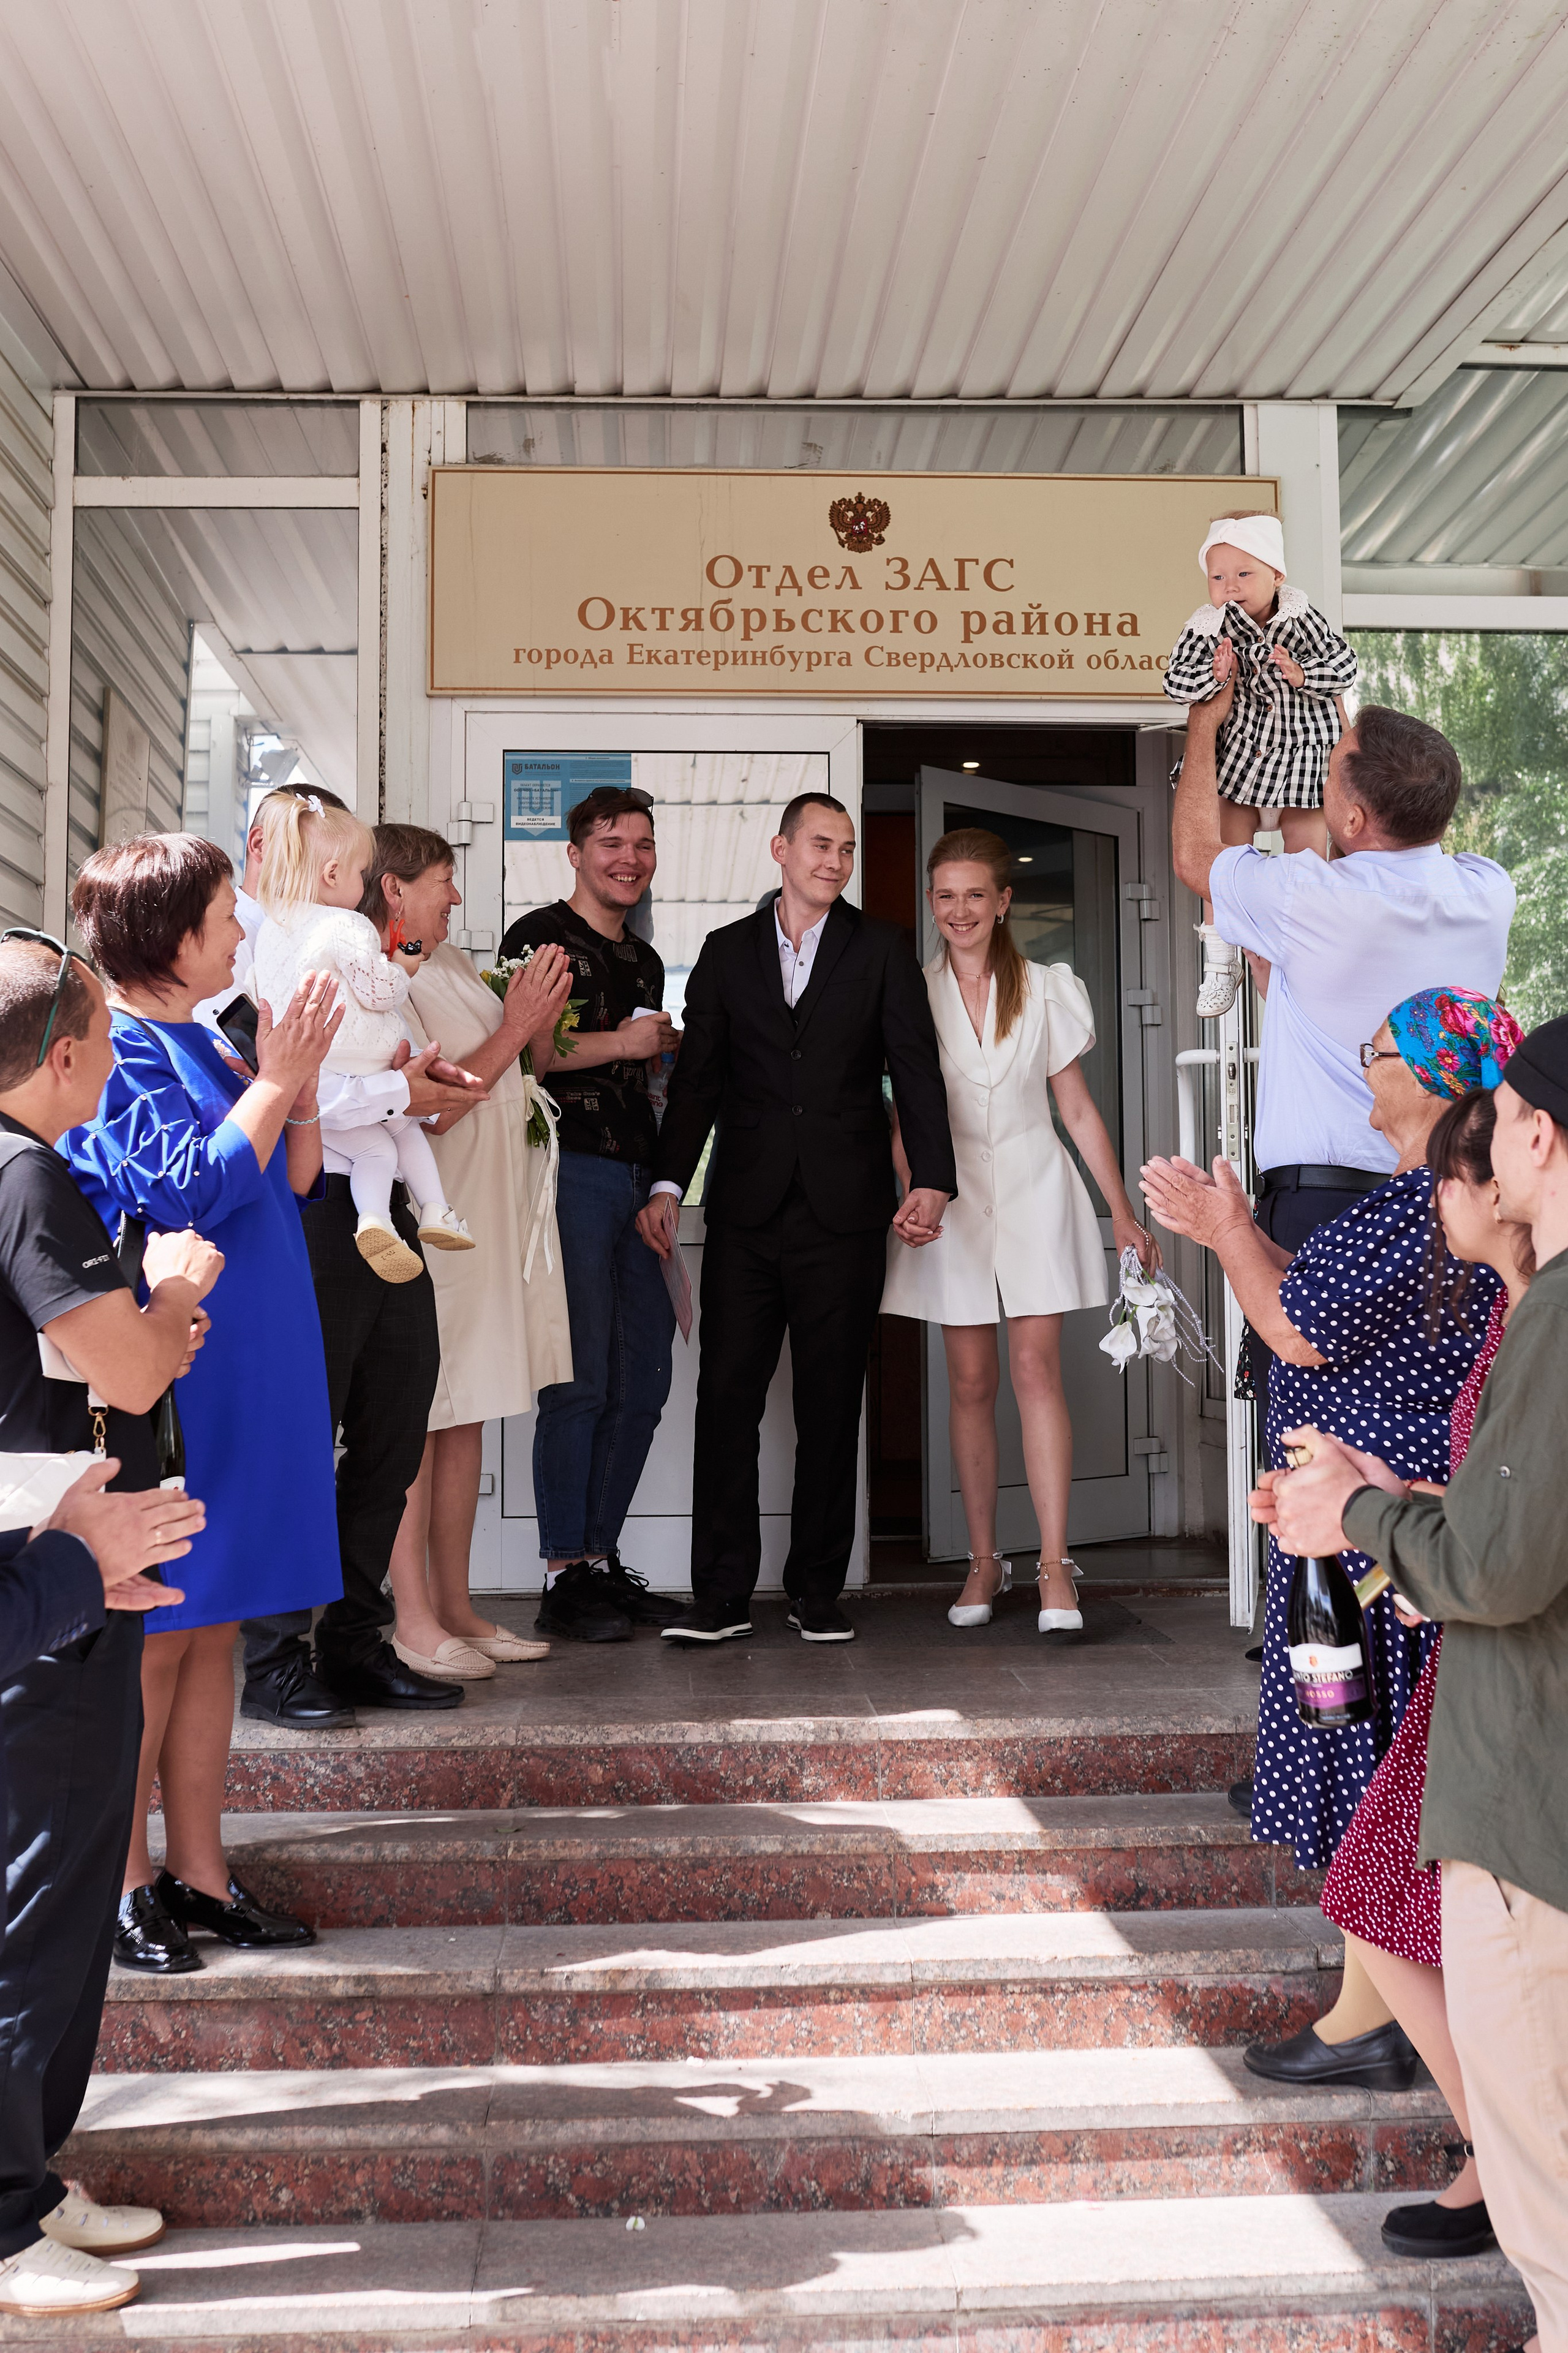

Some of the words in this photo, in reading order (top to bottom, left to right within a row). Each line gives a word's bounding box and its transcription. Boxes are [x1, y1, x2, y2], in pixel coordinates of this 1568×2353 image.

[705, 554, 863, 597] Отдел
[884, 556, 1015, 592] ЗАГС
[577, 596, 938, 641] Октябрьского
[960, 602, 1141, 644] района
[513, 648, 614, 670] города
[626, 643, 853, 673] Екатеринбурга
[864, 645, 1074, 673] Свердловской
[1086, 648, 1169, 671] облас
[1313, 1669, 1353, 1683] STEFANO
